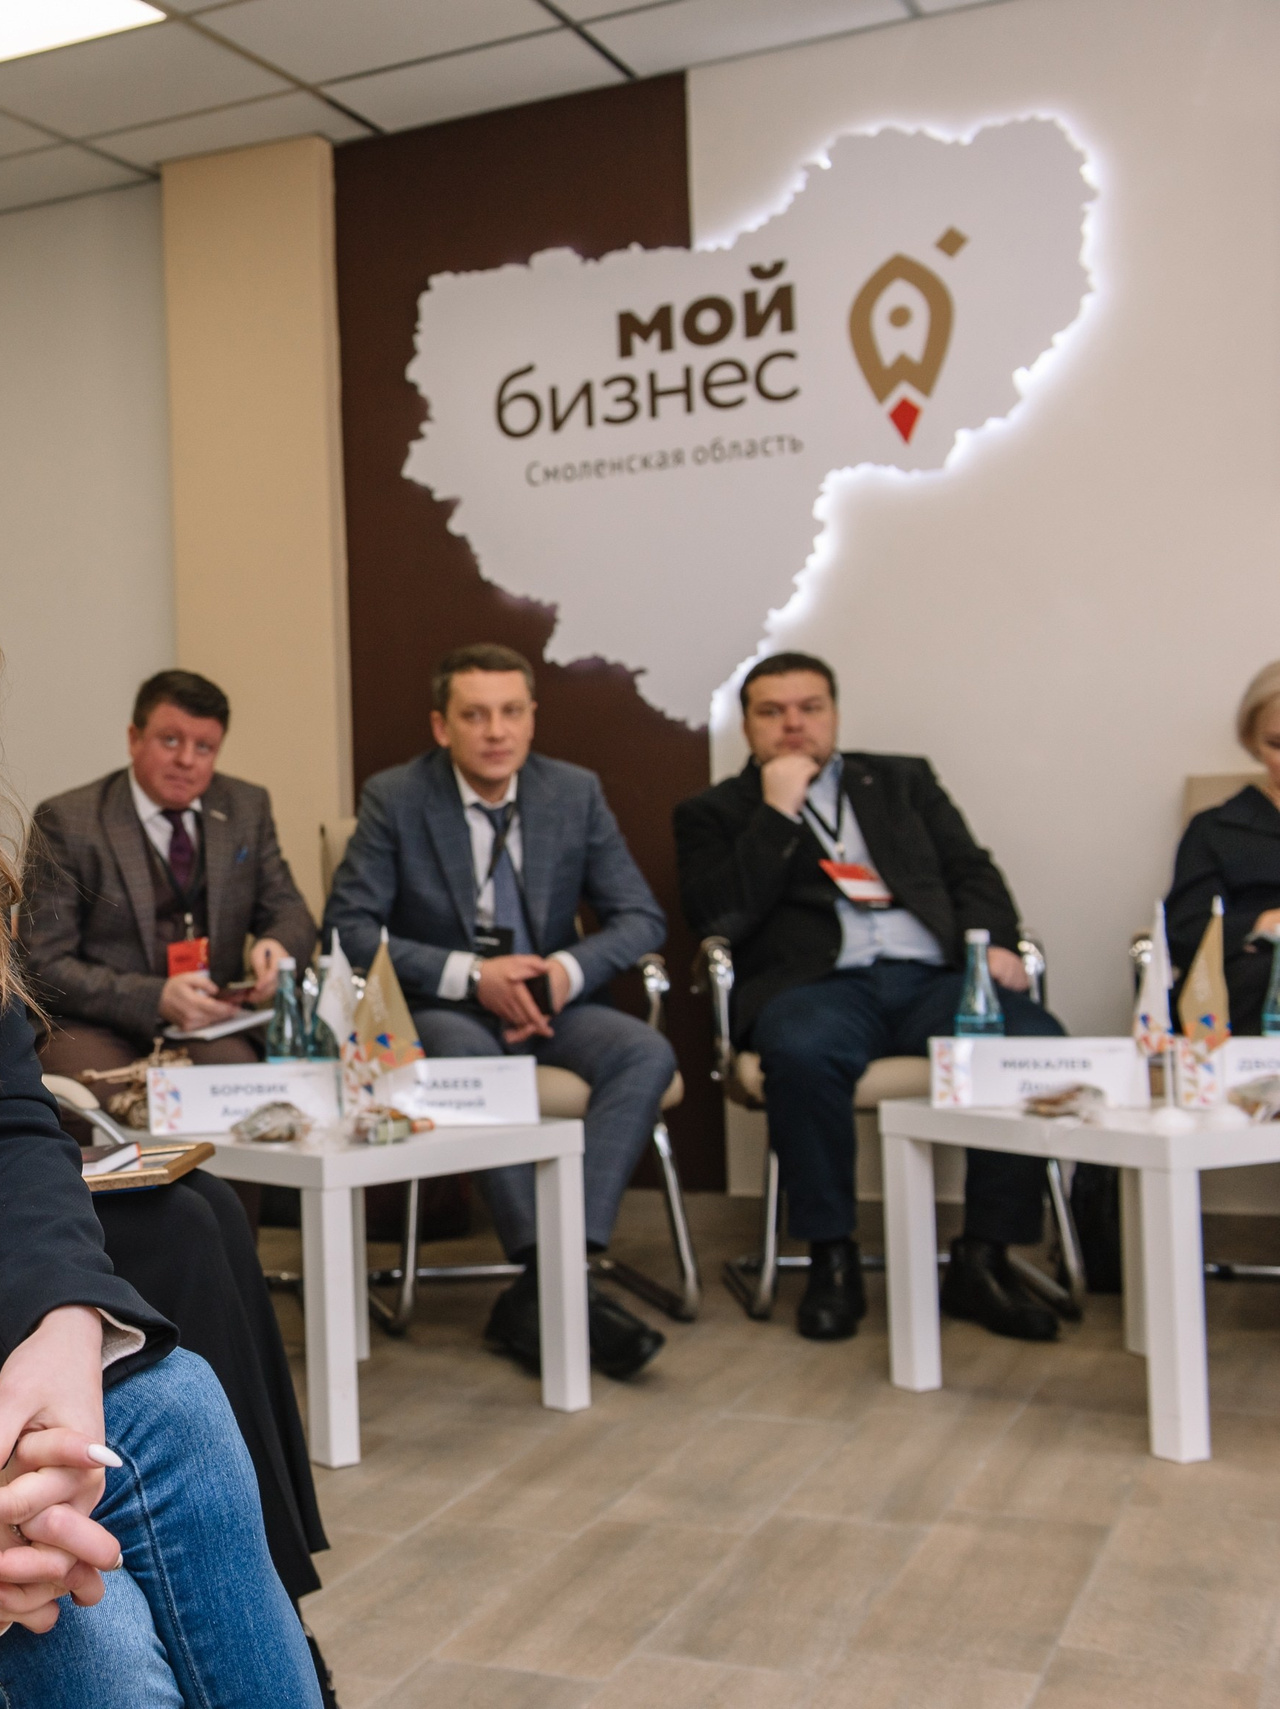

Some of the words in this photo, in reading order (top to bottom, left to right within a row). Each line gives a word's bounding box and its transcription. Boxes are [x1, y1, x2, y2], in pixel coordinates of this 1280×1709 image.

[618, 260, 796, 358] мой
[496, 350, 800, 438] бизнес
[525, 448, 685, 487] Смоленская
[692, 435, 804, 465] область
[210, 1083, 288, 1096] БОРОВИК
